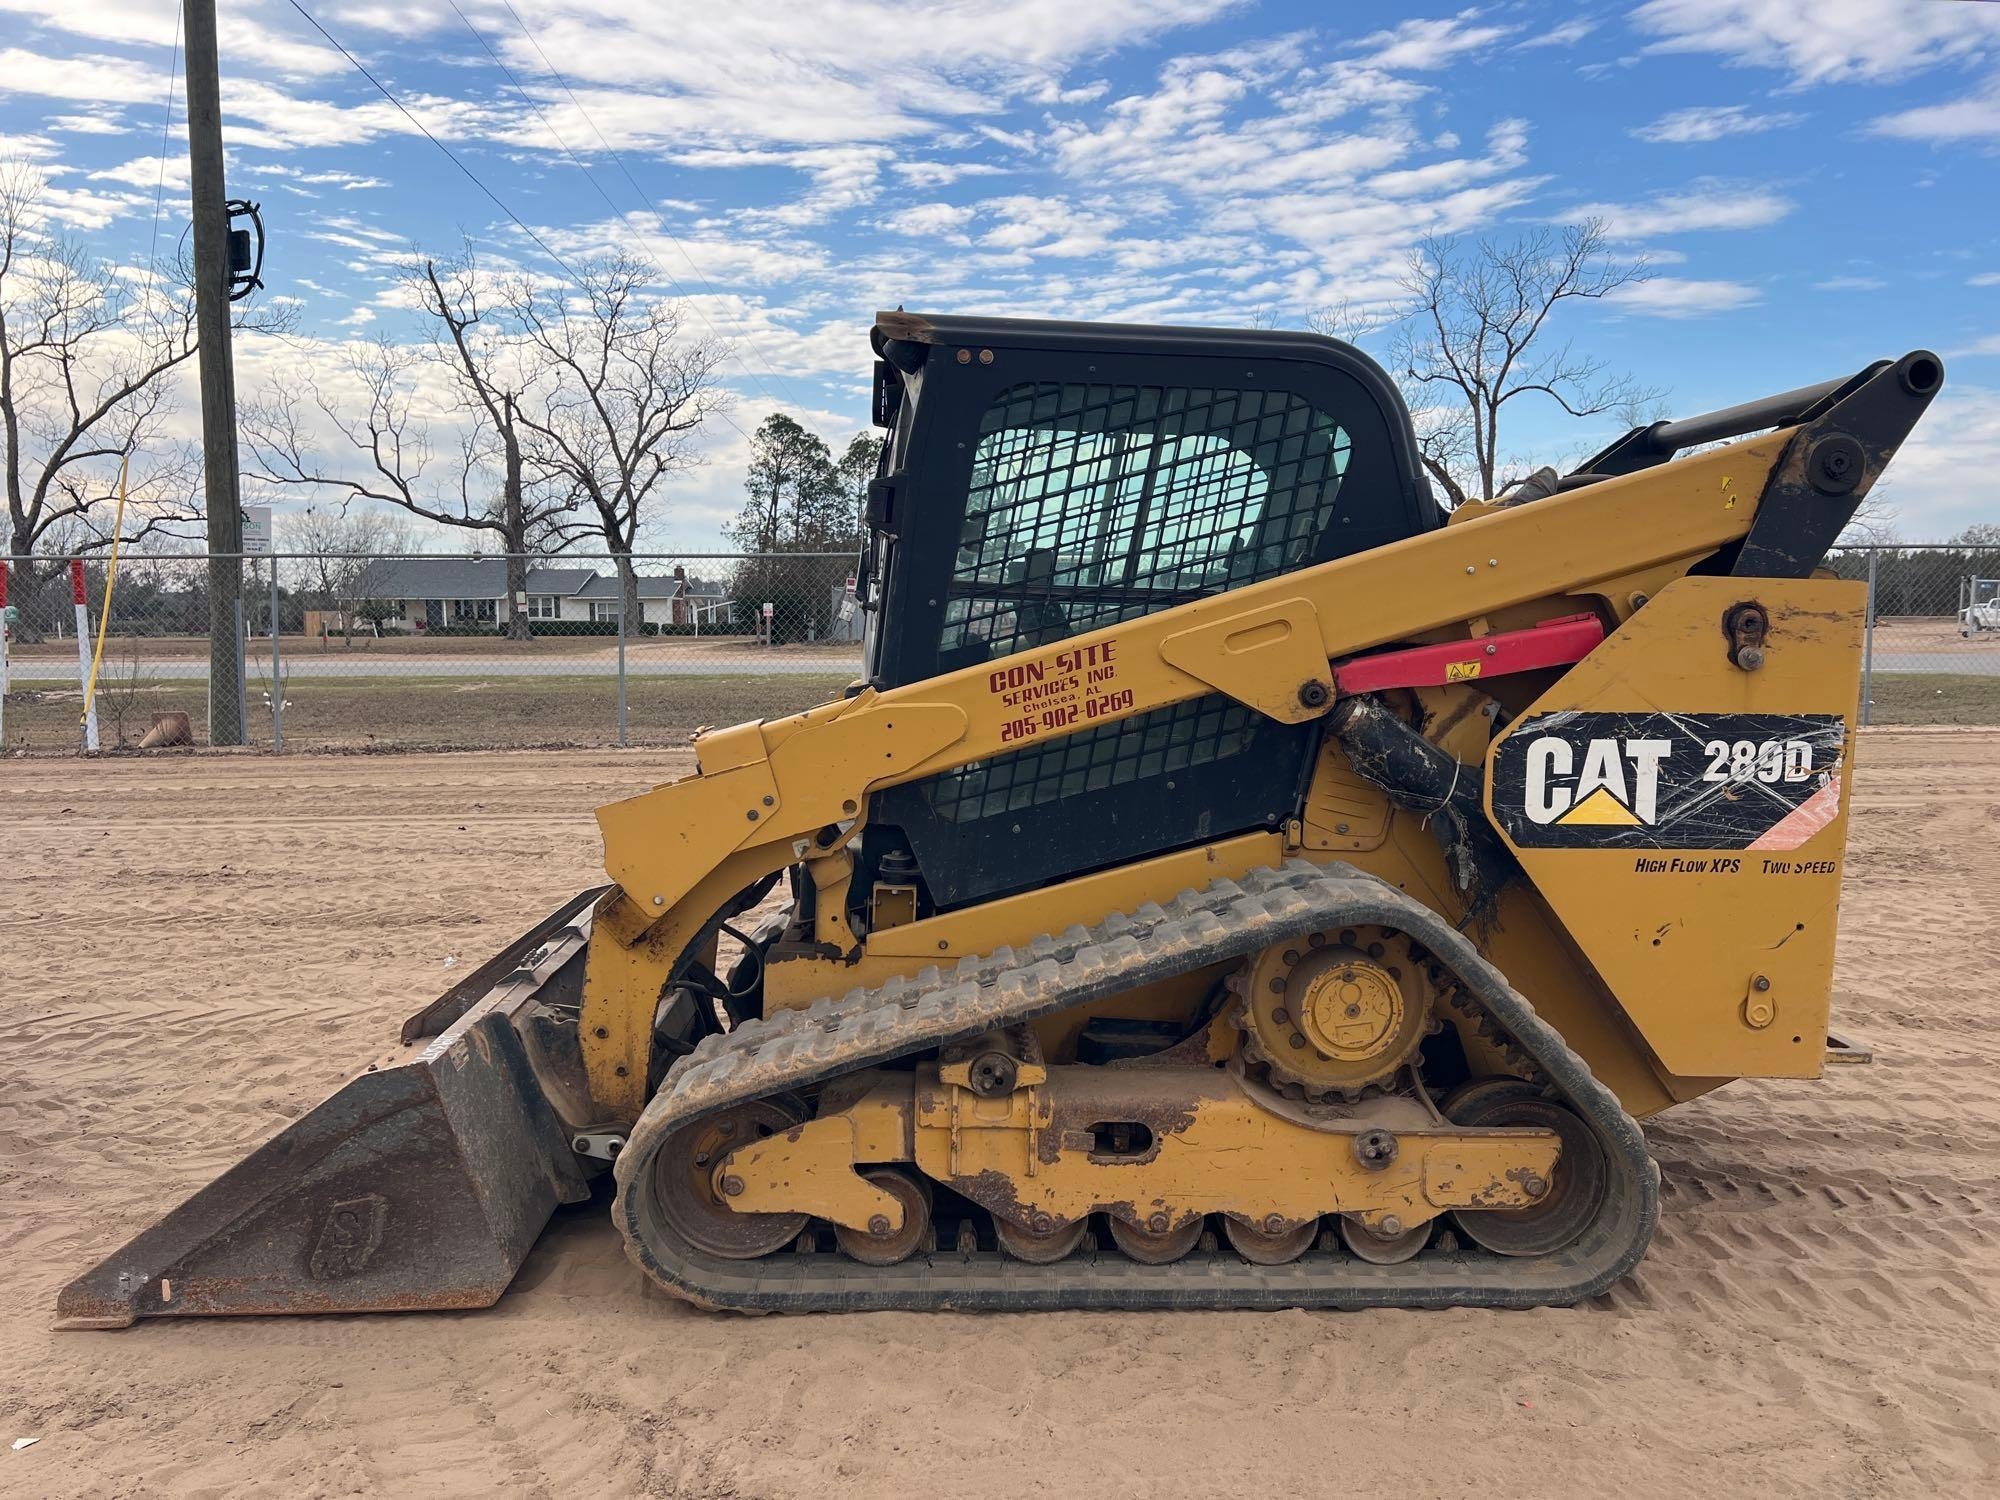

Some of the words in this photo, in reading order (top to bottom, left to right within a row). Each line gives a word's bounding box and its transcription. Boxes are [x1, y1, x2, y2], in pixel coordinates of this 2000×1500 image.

[989, 640, 1117, 694] CON-SITE
[1002, 675, 1080, 708] SERVICES
[1087, 665, 1119, 684] INC.
[1001, 688, 1135, 743] 205-902-0269
[1023, 693, 1081, 714] Chelsea,
[1085, 686, 1102, 695] AL
[1524, 736, 1672, 825] CAT
[1703, 739, 1813, 783] 289D
[1710, 858, 1741, 873] XPS
